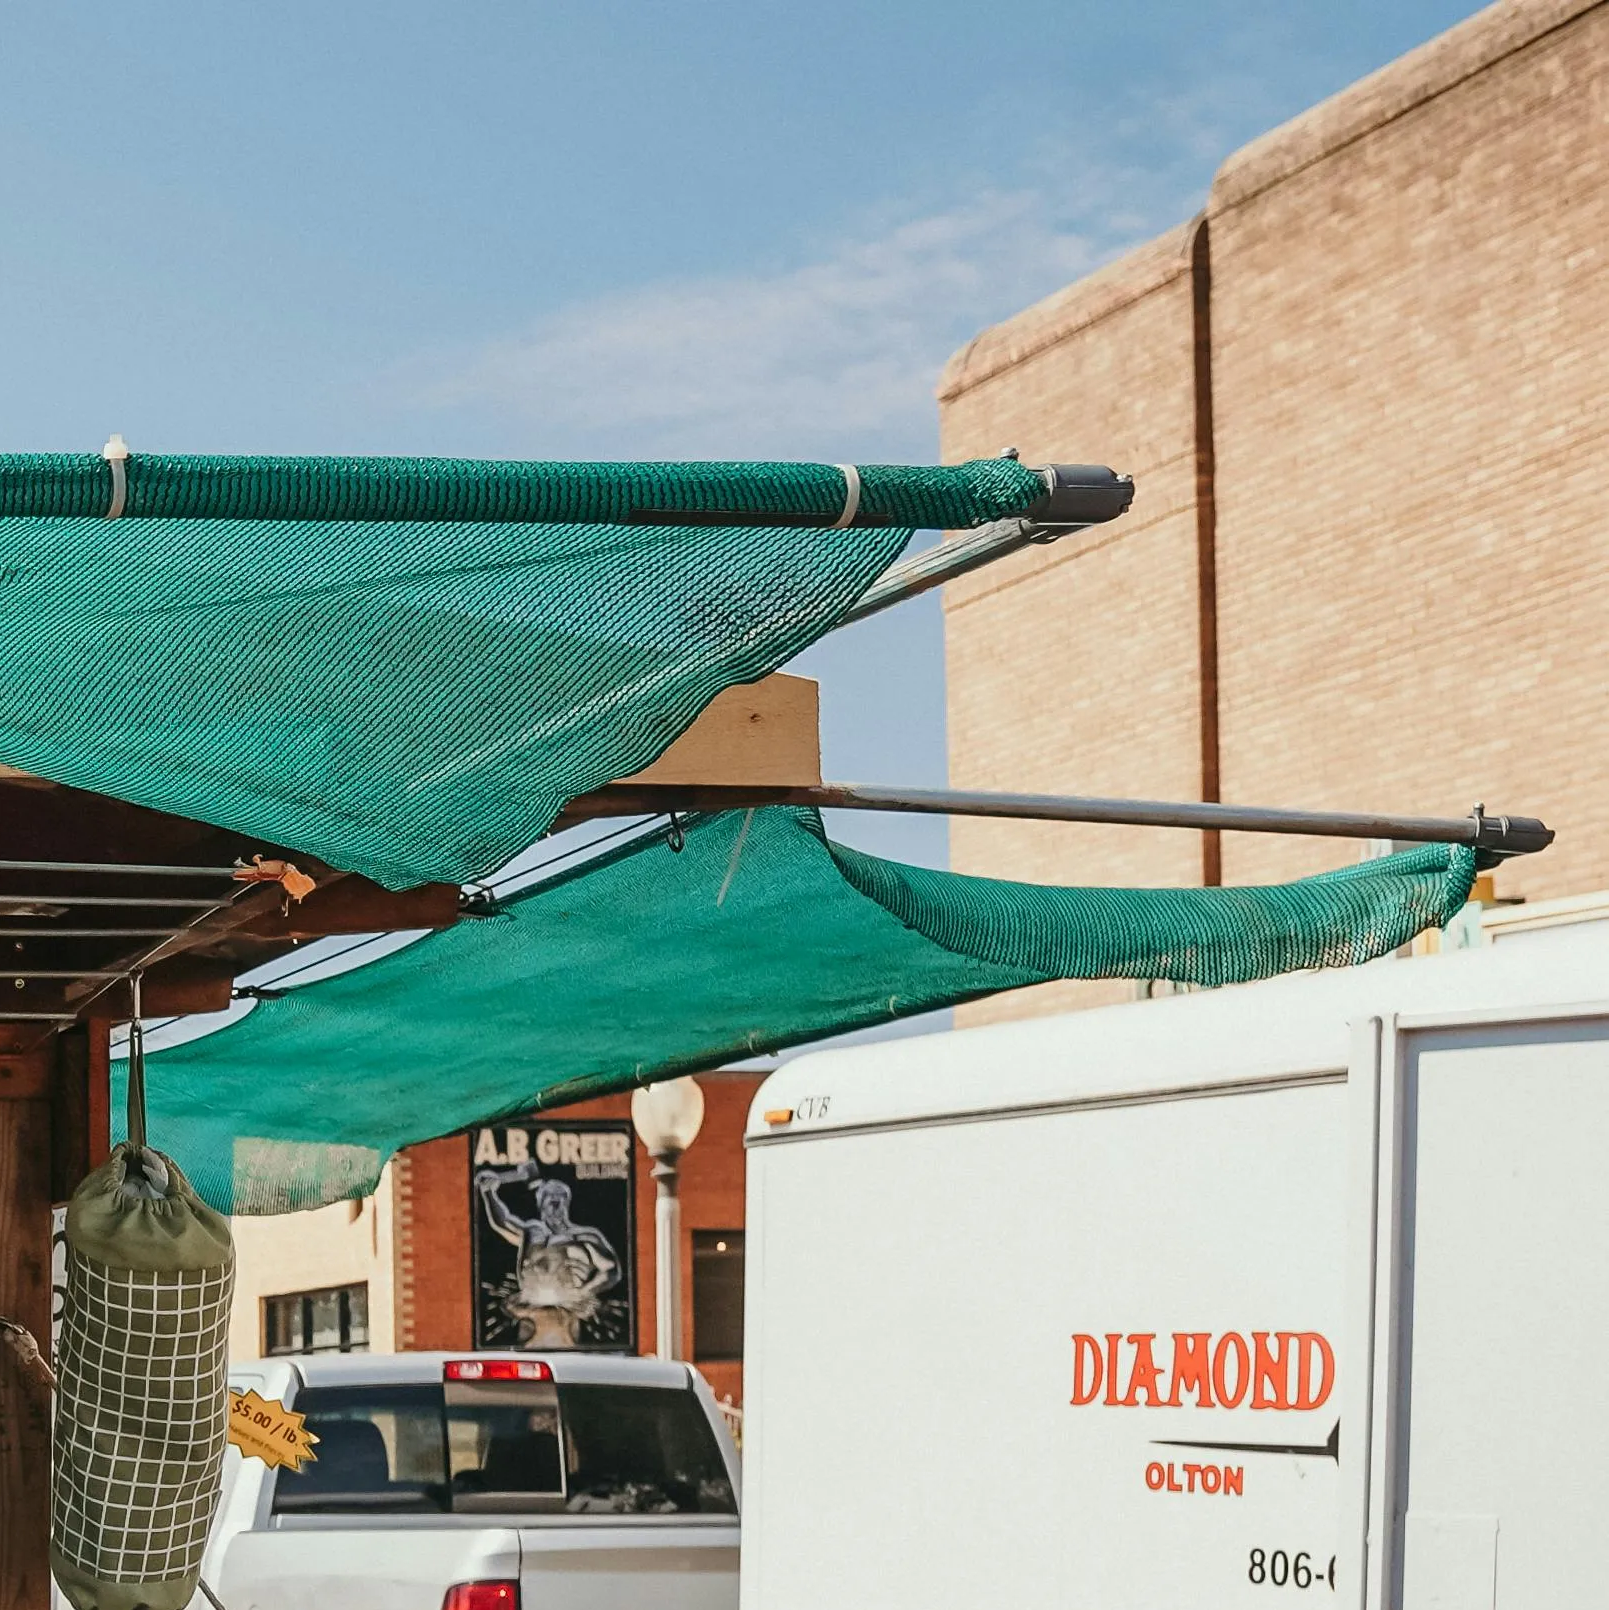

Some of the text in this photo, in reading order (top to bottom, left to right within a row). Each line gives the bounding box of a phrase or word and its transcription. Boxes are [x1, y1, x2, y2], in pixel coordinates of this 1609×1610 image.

[535, 1128, 631, 1166] GREER
[1069, 1331, 1336, 1411] DIAMOND
[232, 1399, 272, 1429] $5.00
[1144, 1461, 1245, 1497] OLTON
[1247, 1547, 1337, 1592] 806-
